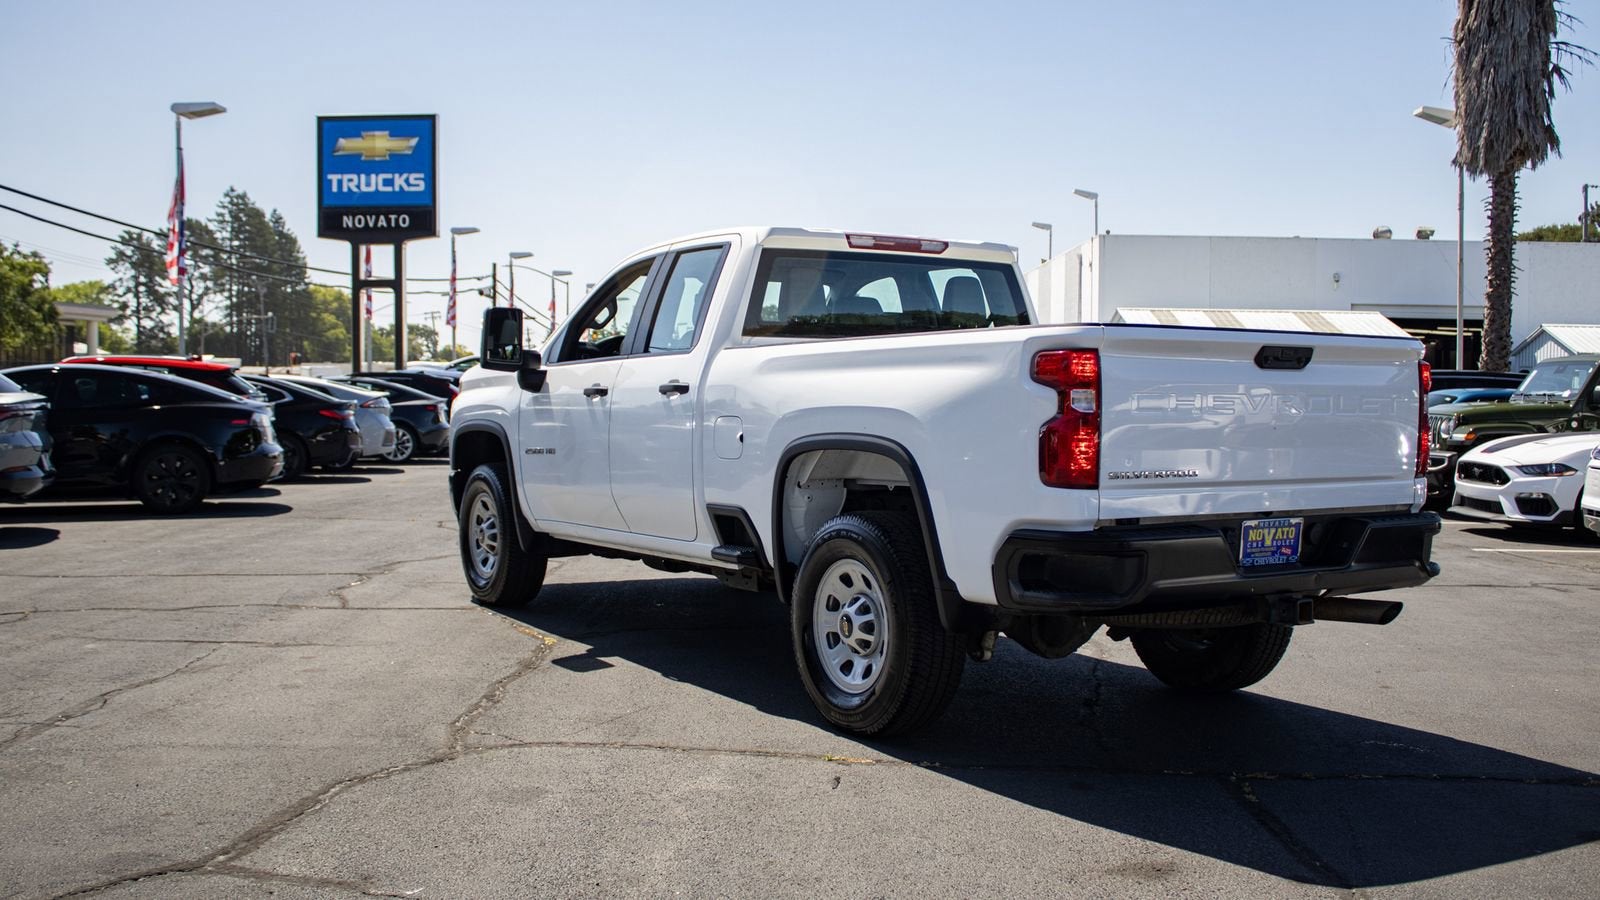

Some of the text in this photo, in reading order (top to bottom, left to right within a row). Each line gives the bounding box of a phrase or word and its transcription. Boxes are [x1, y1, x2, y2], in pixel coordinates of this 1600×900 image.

[327, 173, 425, 192] TRUCKS
[342, 214, 410, 228] NOVATO
[1130, 392, 1403, 416] CHEVROLET
[1107, 469, 1199, 480] SILVERADO
[1248, 527, 1296, 546] NOVATO
[1253, 556, 1287, 565] CHEVROLET
